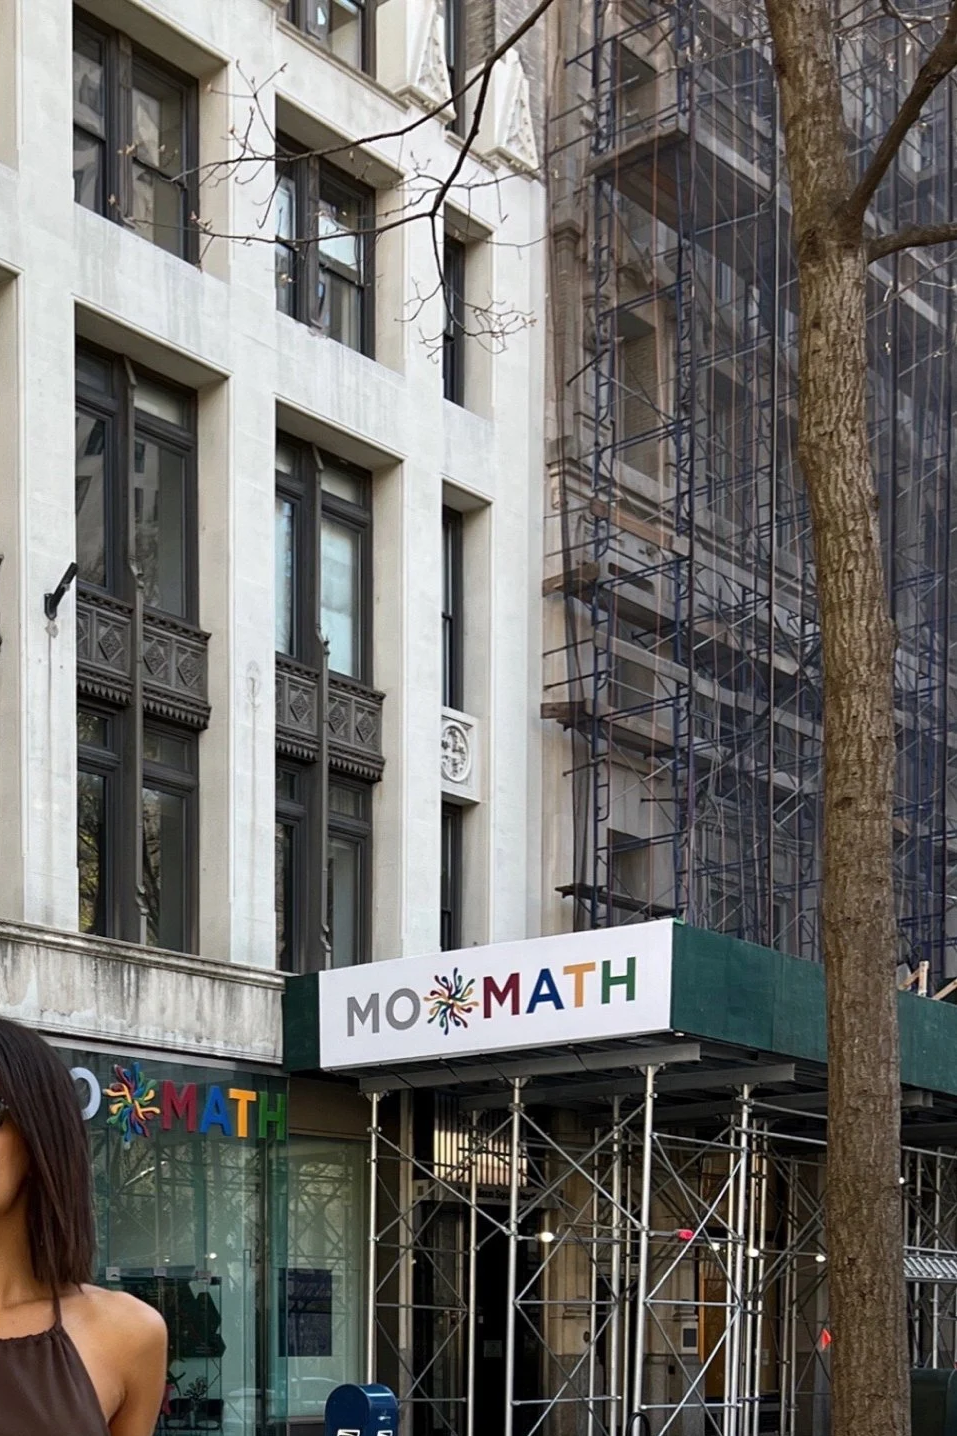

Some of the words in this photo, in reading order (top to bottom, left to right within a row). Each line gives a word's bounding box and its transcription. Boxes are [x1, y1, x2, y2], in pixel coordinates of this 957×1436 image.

[346, 987, 421, 1037] MO
[483, 956, 636, 1019] MATH
[69, 1066, 102, 1121] O
[162, 1079, 287, 1141] MATH
